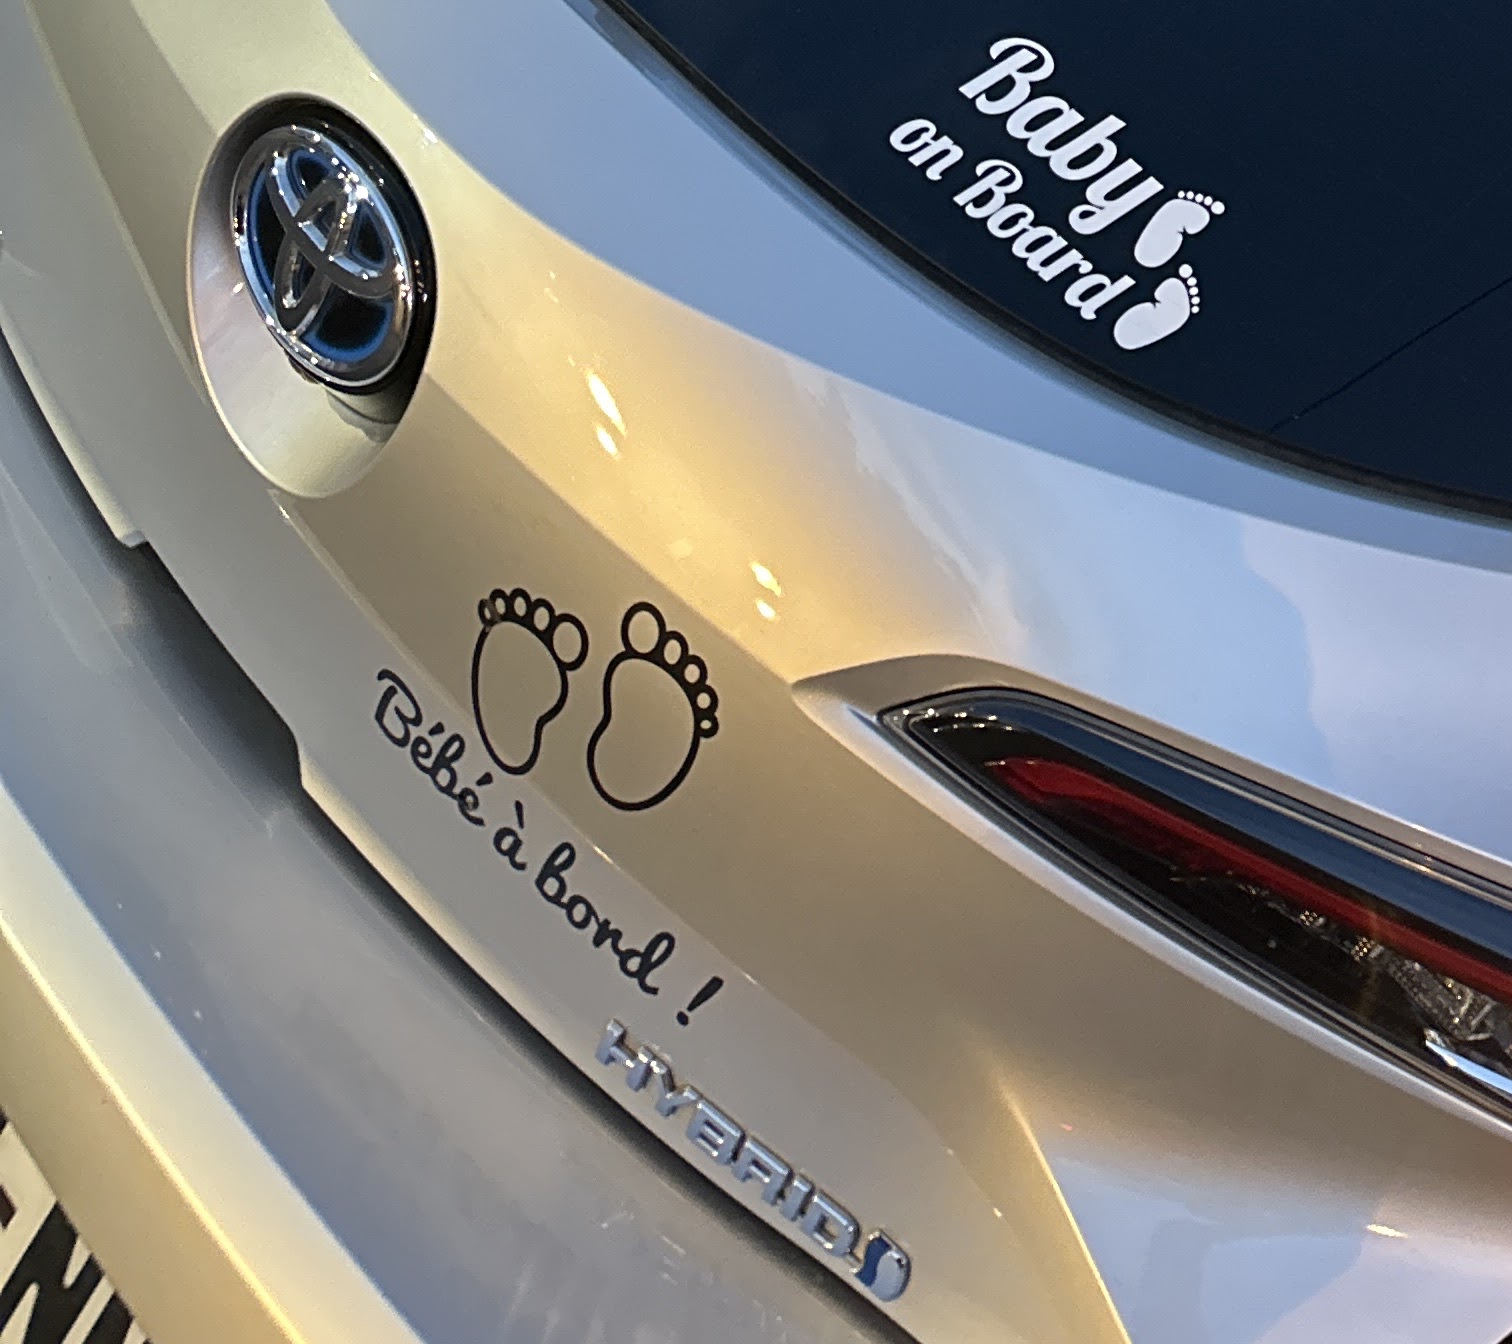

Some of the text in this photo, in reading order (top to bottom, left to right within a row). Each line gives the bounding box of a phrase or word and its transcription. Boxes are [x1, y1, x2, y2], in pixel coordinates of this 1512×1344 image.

[889, 118, 1137, 321] on Board
[958, 37, 1165, 236] Baby
[374, 668, 494, 827] Bébé
[493, 800, 527, 872] à
[534, 841, 676, 996] bord
[594, 1017, 863, 1259] HYBRID
